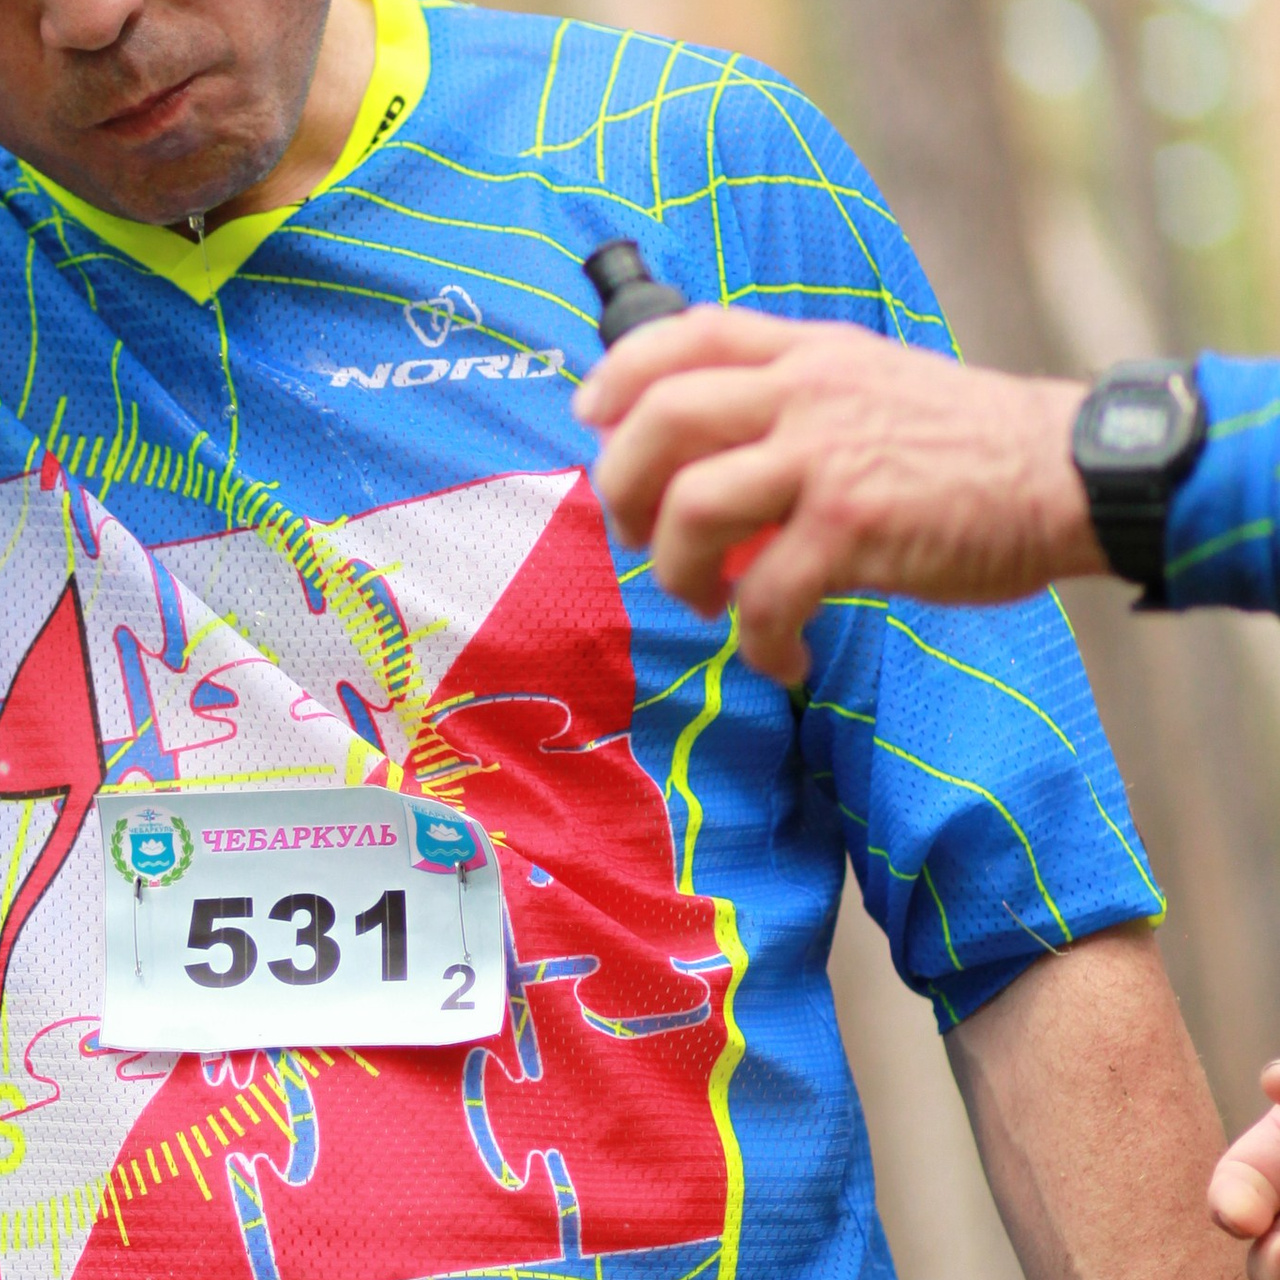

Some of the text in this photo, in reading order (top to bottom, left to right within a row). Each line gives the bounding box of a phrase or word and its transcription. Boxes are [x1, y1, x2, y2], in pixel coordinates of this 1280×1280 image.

[329, 348, 566, 389] NORD
[202, 824, 398, 852] ЧЕБАРКУЛЬ
[184, 890, 408, 988] 531
[441, 963, 476, 1010] 2
